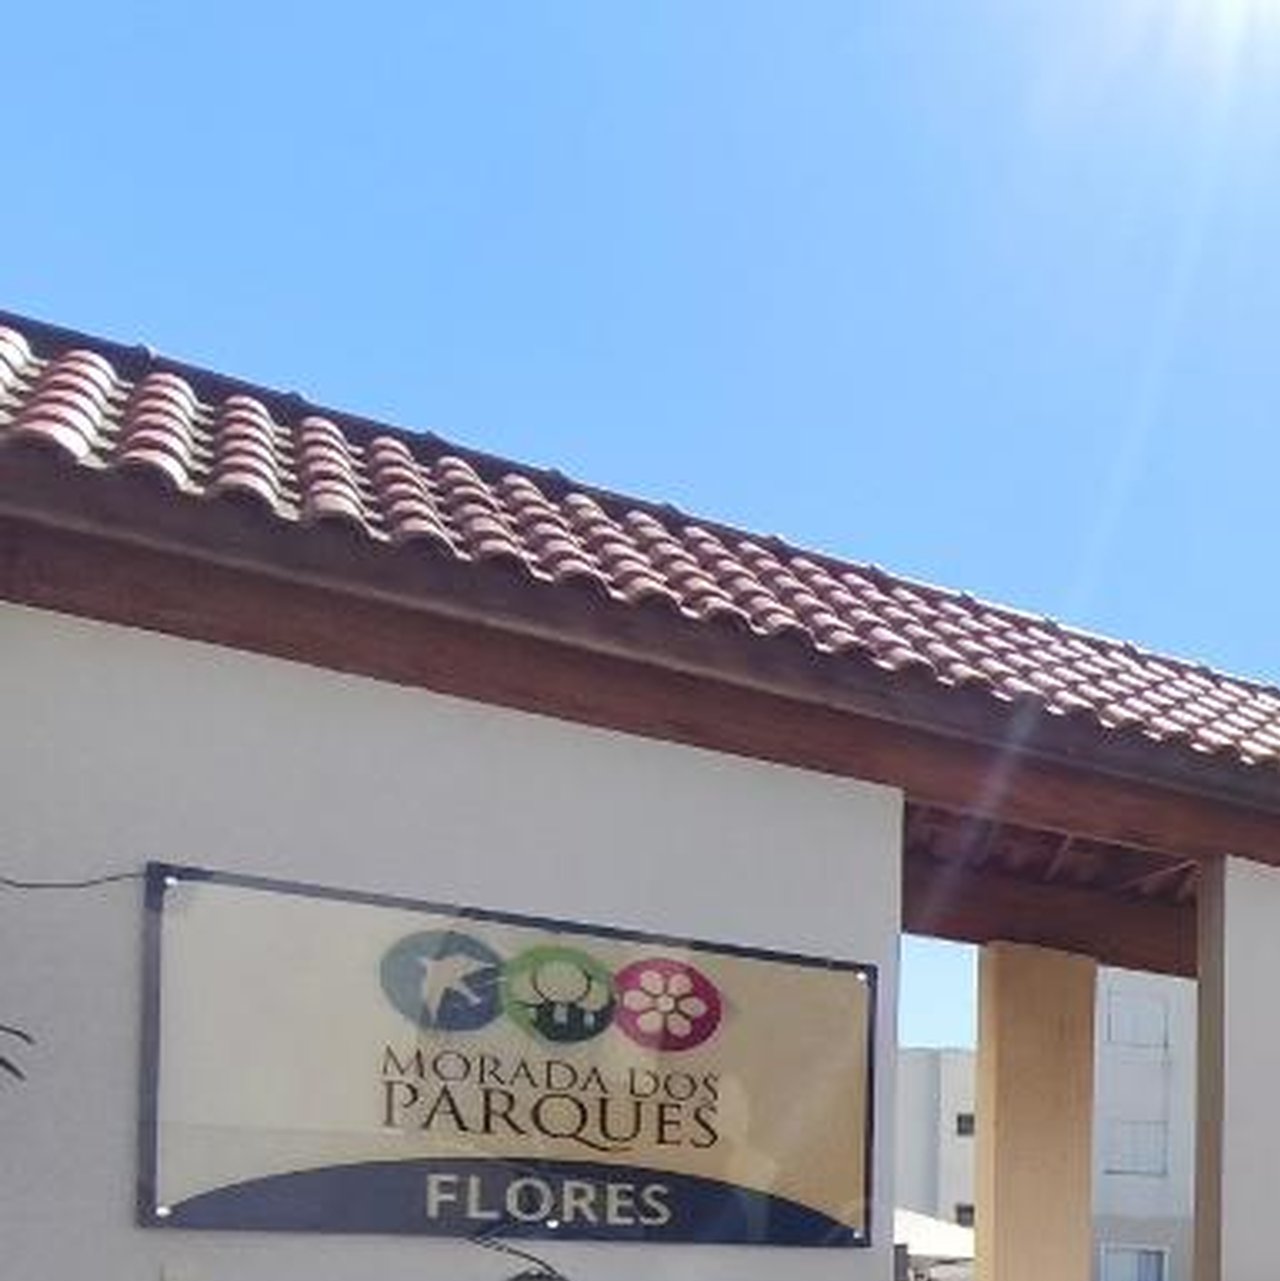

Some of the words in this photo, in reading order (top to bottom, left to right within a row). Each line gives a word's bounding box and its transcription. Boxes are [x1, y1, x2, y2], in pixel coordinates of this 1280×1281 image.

[382, 1045, 609, 1094] MORADA
[629, 1067, 720, 1103] DOS
[382, 1081, 720, 1152] PARQUES
[426, 1174, 672, 1226] FLORES
